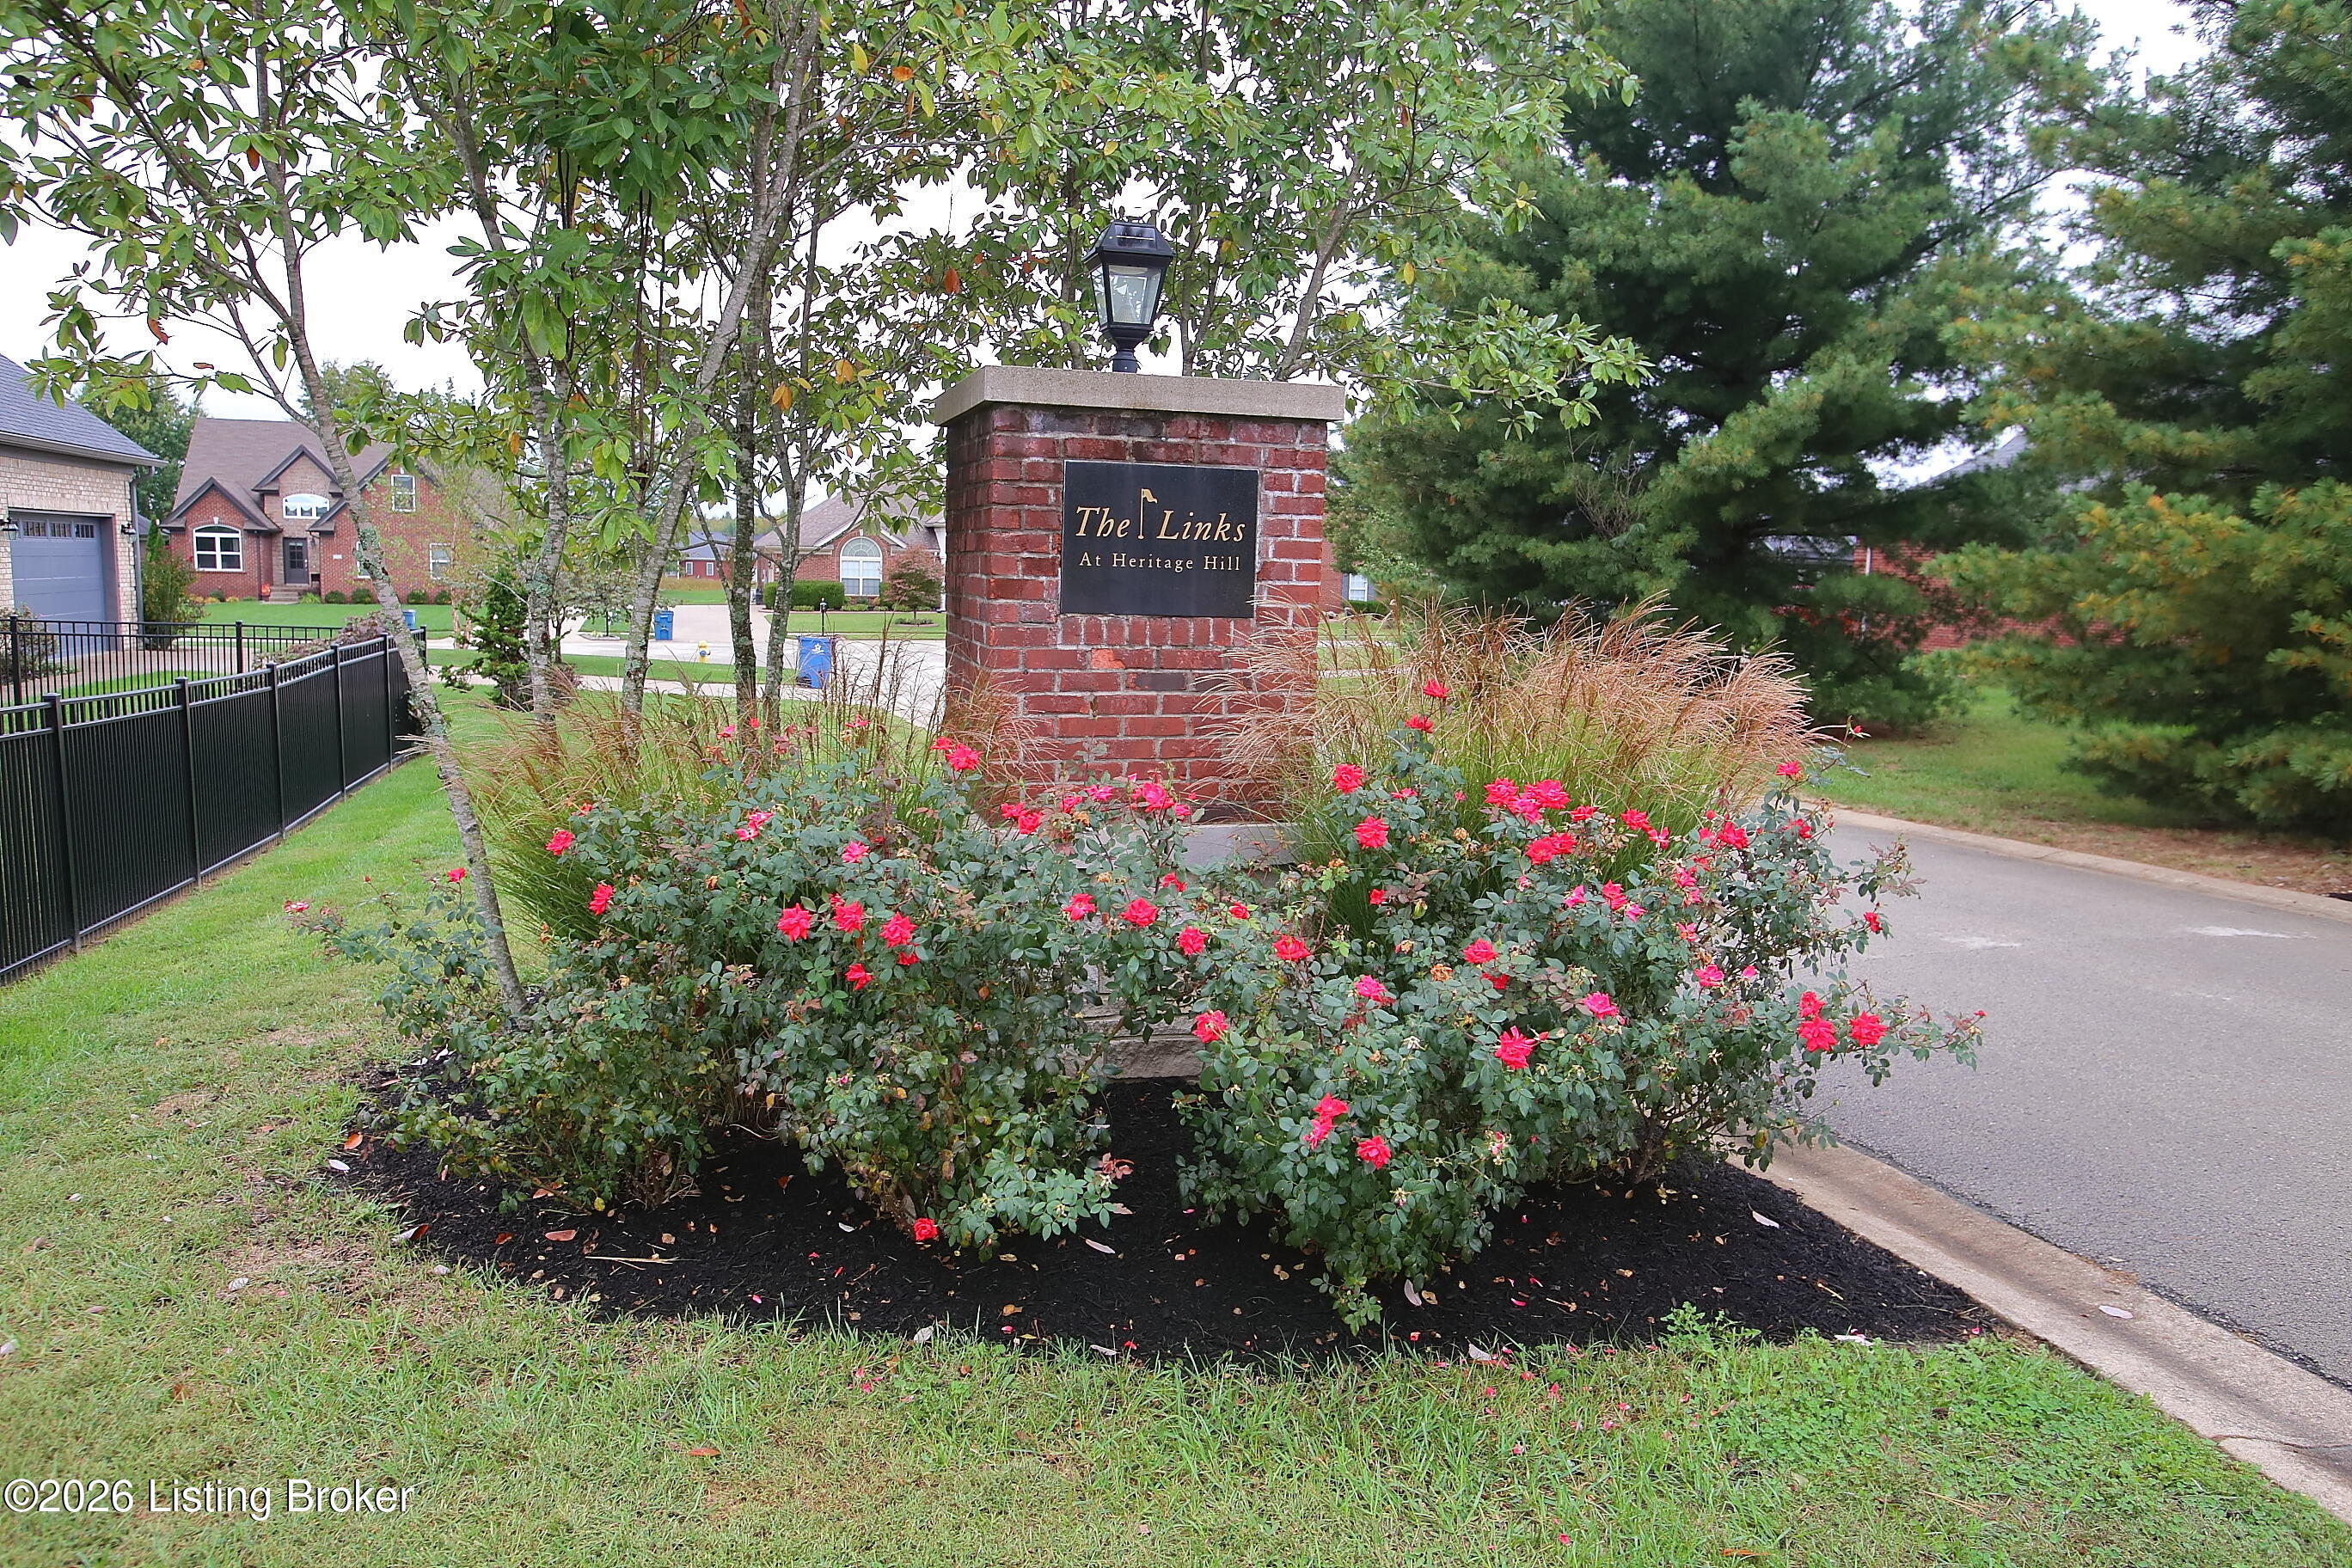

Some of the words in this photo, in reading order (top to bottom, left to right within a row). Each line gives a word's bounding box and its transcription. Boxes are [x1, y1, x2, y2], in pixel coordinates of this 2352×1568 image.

[1075, 506, 1130, 538] The
[1156, 510, 1246, 542] Links
[1079, 552, 1101, 567] At
[1112, 553, 1194, 573] Heritage
[1204, 555, 1240, 571] Hill
